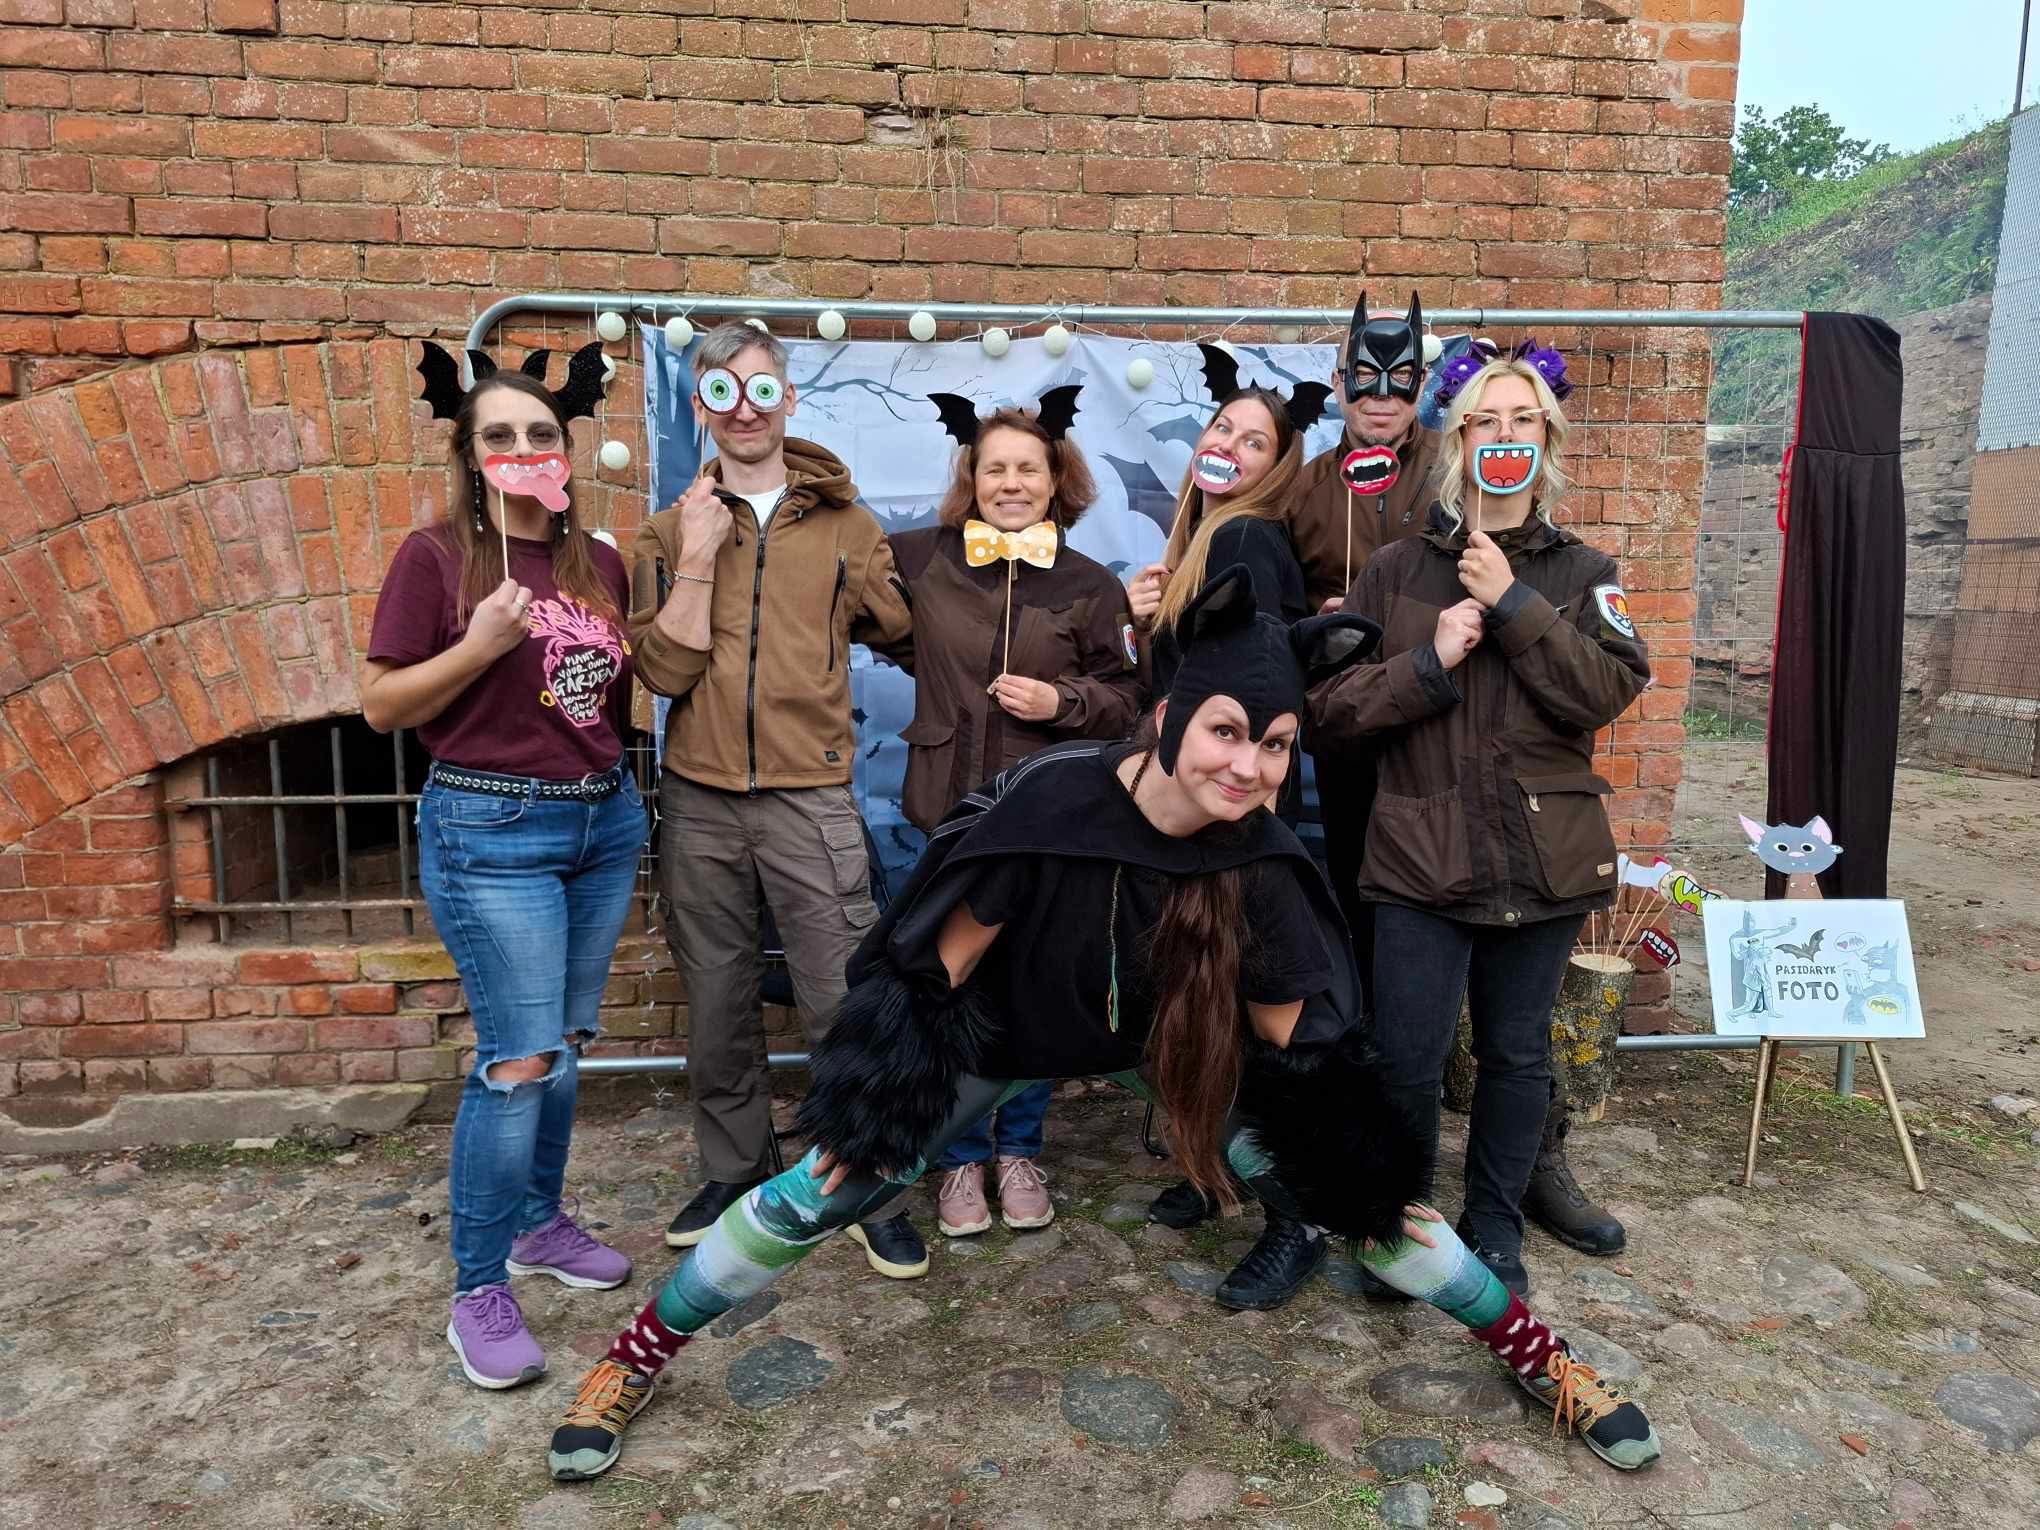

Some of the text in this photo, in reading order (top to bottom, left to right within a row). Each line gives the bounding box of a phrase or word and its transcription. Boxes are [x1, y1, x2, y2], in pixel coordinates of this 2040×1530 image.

[558, 655, 611, 679] YOUR OWN
[565, 649, 596, 667] PLANT
[553, 667, 618, 696] GARDEN
[1775, 965, 1836, 975] PASIDARYK
[1777, 981, 1839, 1000] FOTO
